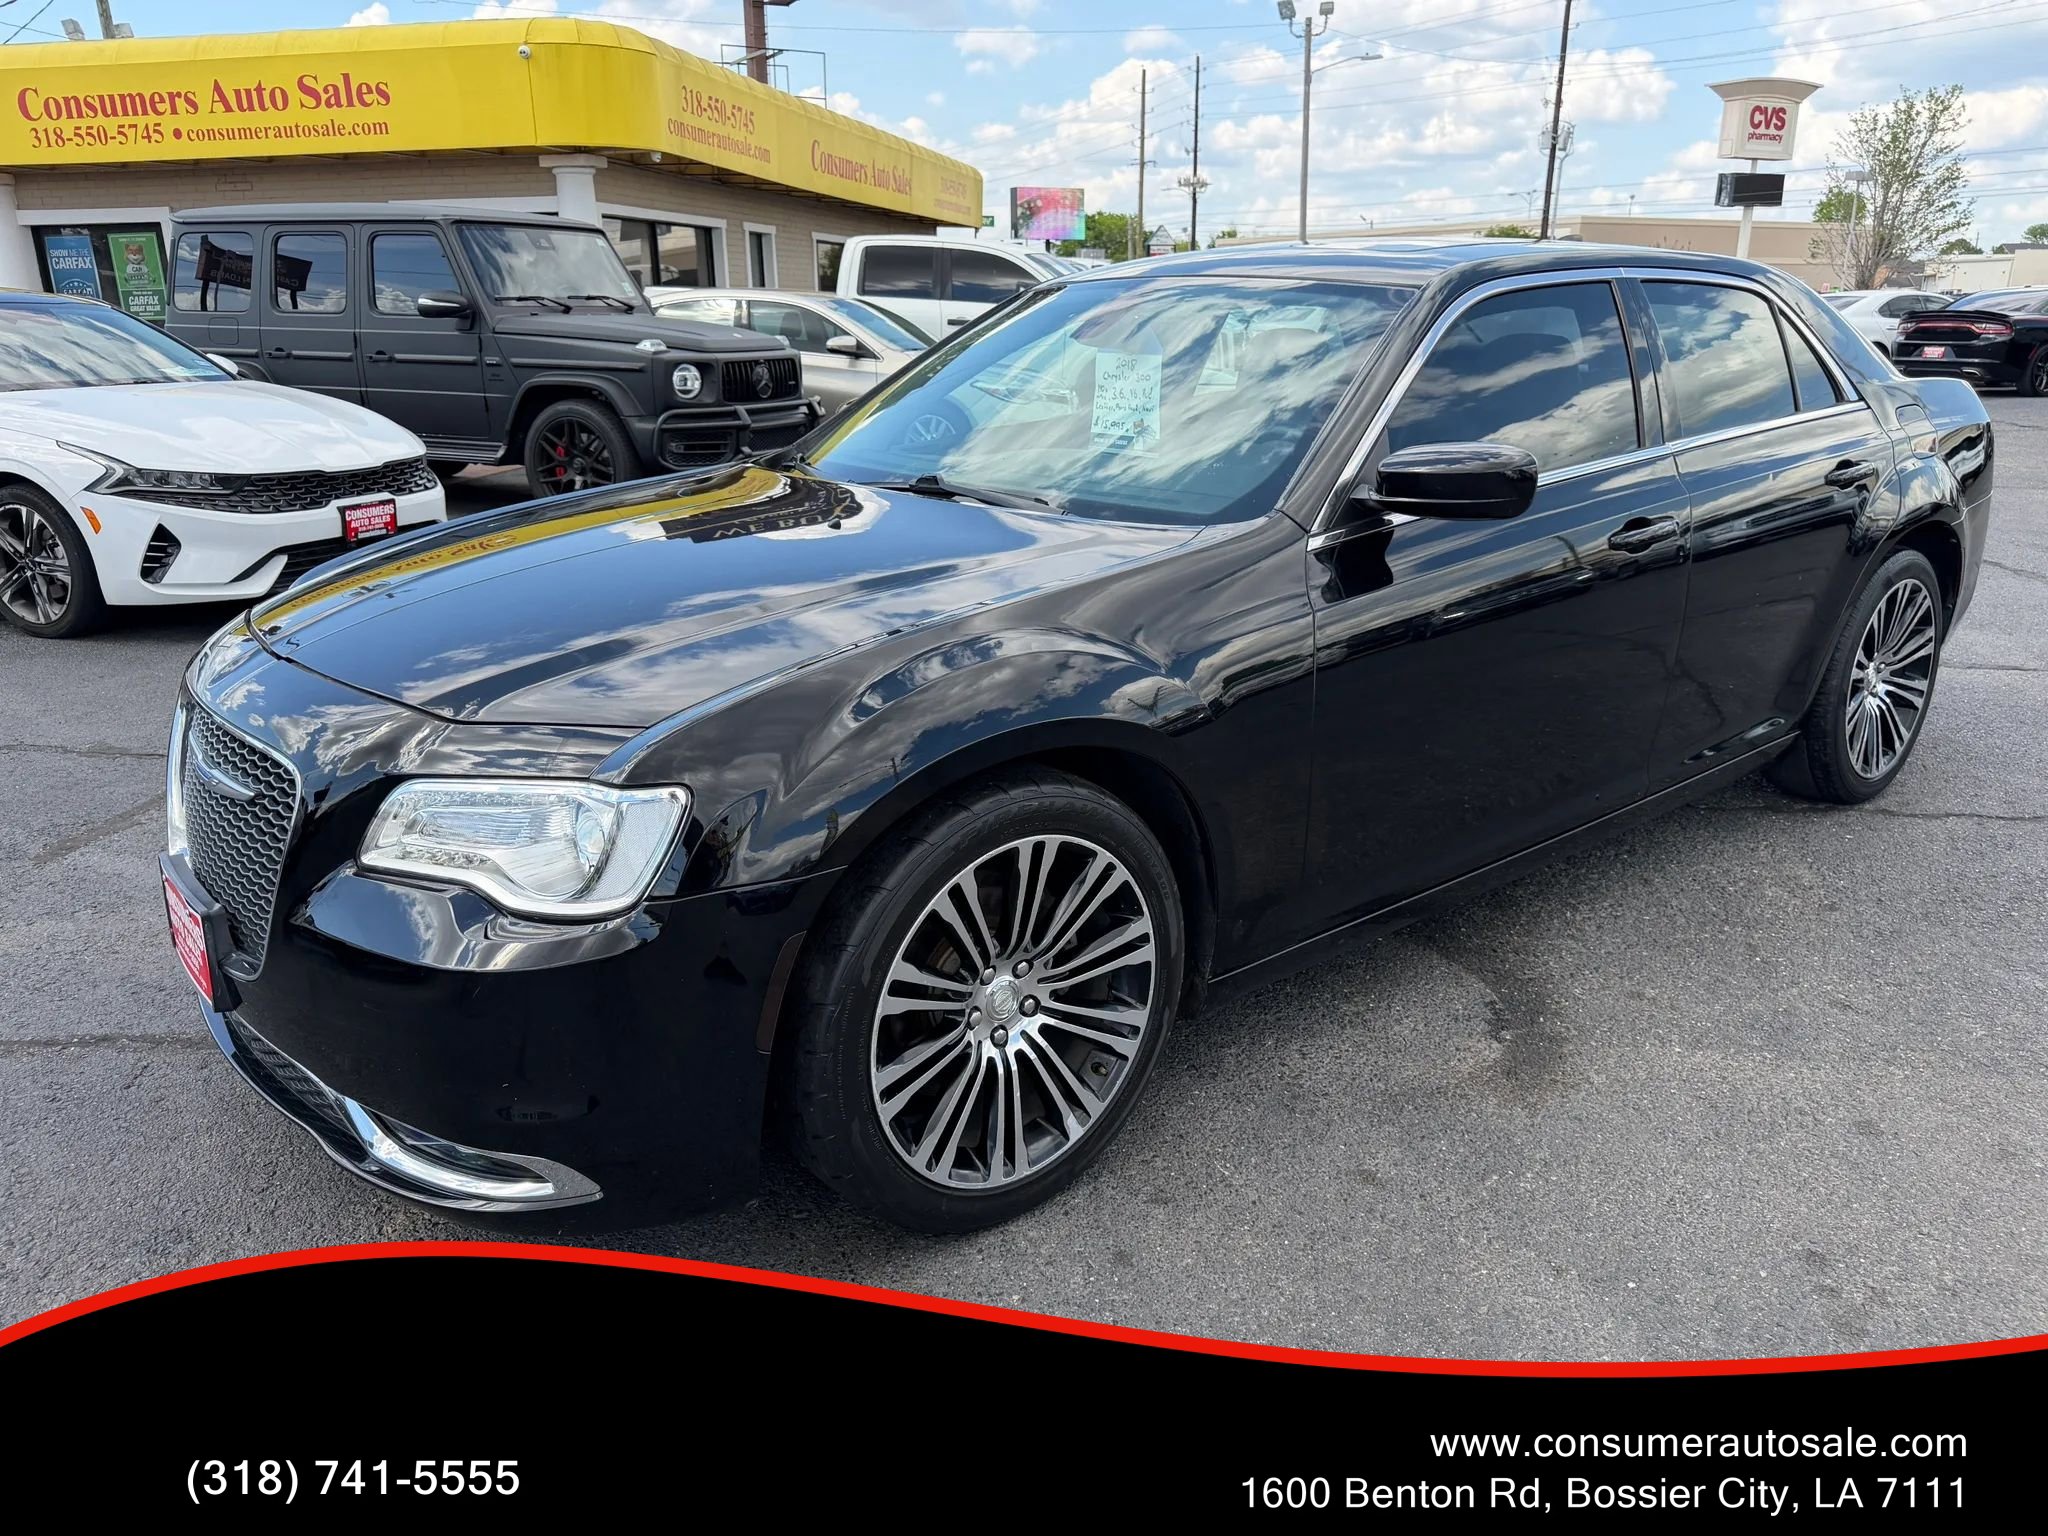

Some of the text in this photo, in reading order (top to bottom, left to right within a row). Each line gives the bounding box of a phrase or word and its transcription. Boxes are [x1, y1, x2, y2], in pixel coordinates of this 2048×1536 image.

[17, 72, 391, 122] Consumers Auto Sales
[682, 85, 755, 135] 318-550-5745
[1749, 105, 1787, 131] CVS
[30, 119, 390, 149] 318-550-5745 consumerautosale.com
[667, 117, 771, 164] consumerautosale.com
[1747, 130, 1783, 143] pharmacy
[811, 139, 868, 185] Consumers
[869, 157, 891, 191] Auto
[892, 165, 912, 197] Sales
[49, 247, 91, 257] SHOW ME THE
[51, 256, 93, 270] CARFAX
[128, 295, 159, 305] CARFAX
[1117, 357, 1137, 371] 2018
[345, 504, 395, 521] CONSUMERS
[350, 518, 370, 528] AUTO
[370, 514, 391, 525] SALES
